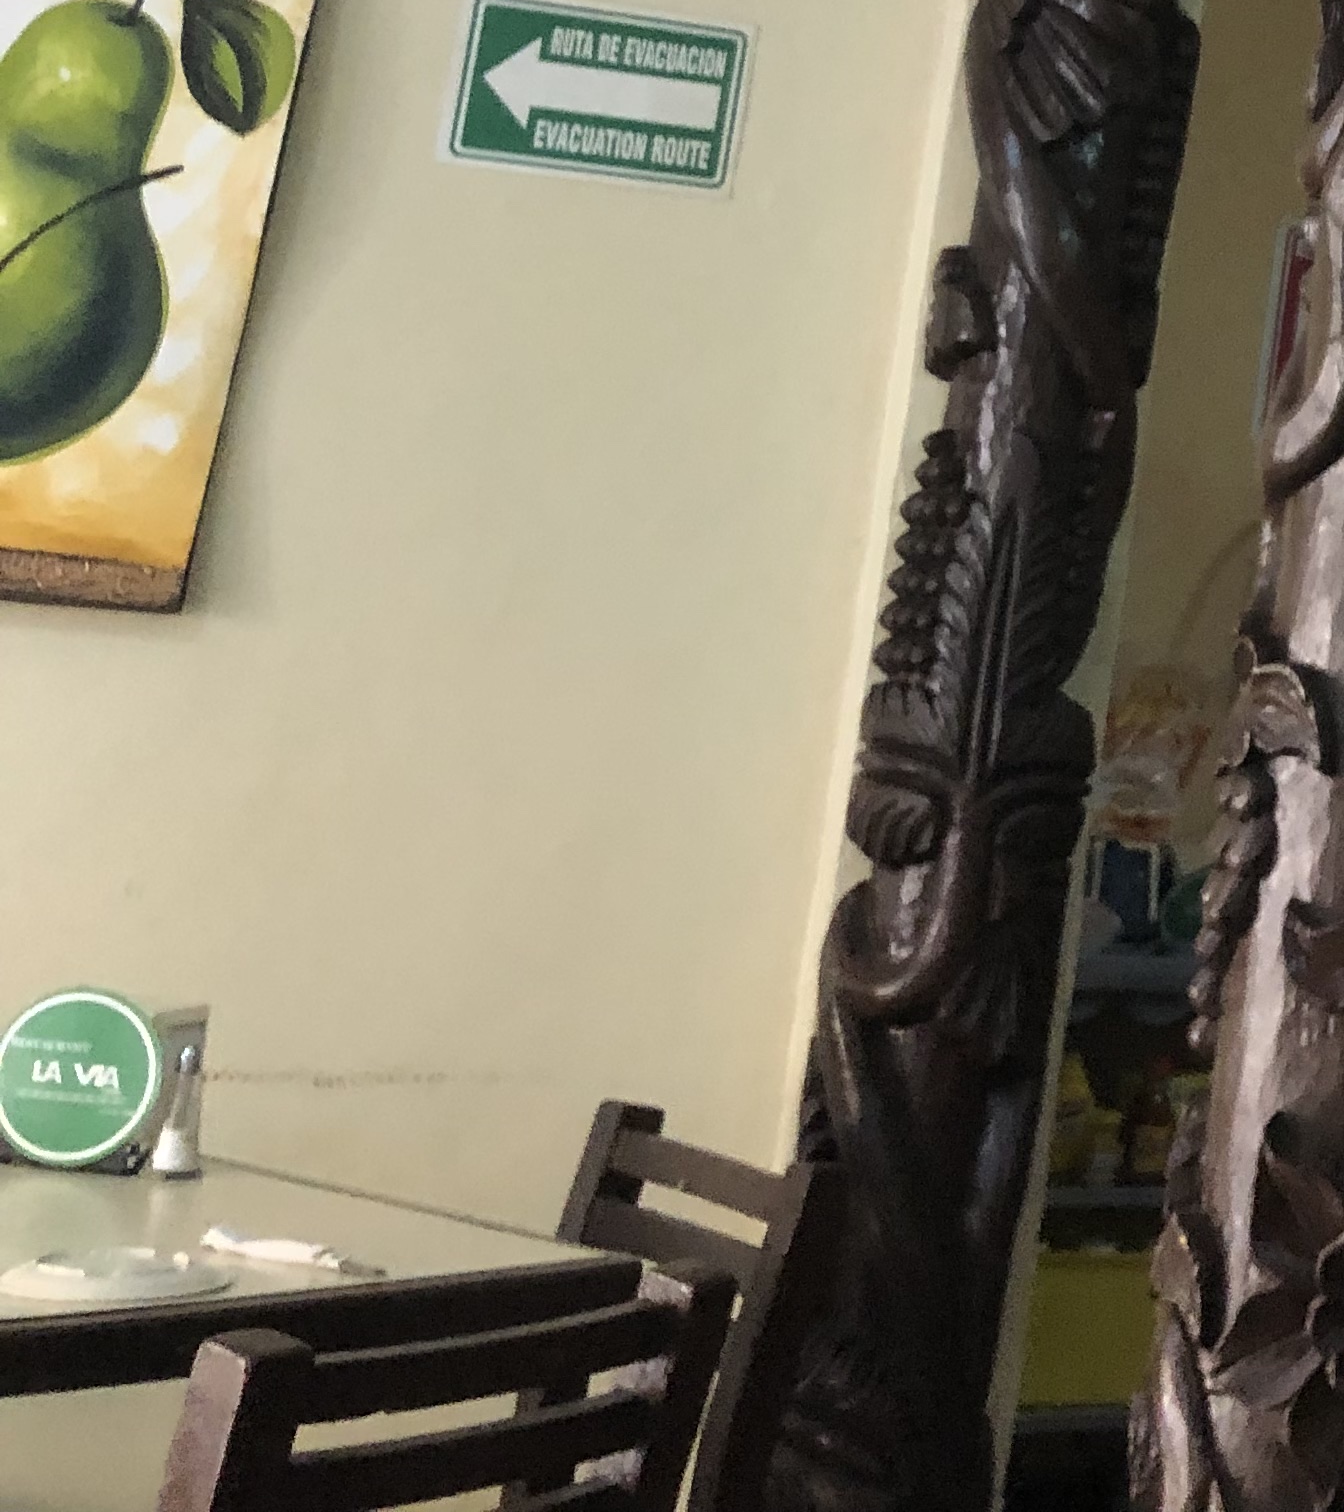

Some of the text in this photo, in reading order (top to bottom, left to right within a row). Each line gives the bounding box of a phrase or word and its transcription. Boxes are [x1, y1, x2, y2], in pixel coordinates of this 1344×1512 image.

[551, 25, 594, 59] RUTA
[598, 32, 623, 64] DE
[533, 119, 713, 171] EVACUATION ROUTE
[31, 1059, 120, 1090] LA VIA
